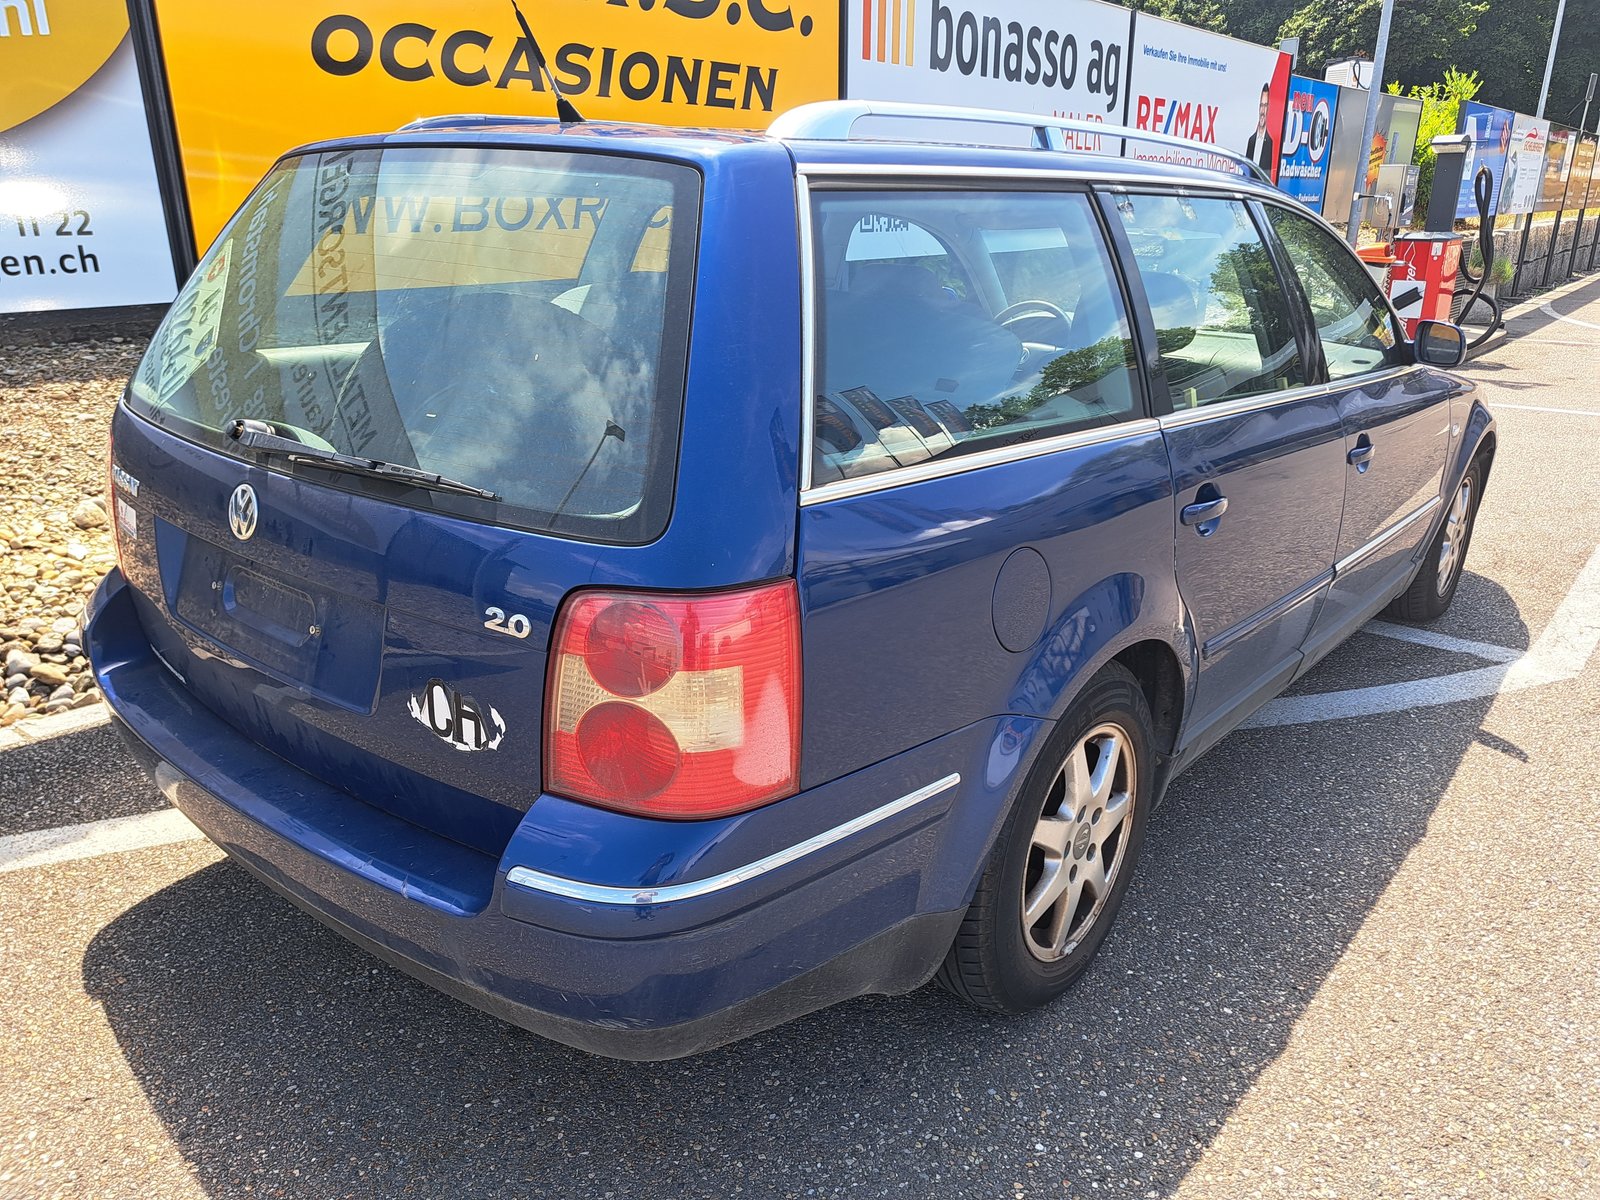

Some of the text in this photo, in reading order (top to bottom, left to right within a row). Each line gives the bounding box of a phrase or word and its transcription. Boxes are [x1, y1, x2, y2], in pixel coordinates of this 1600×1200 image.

[310, 14, 779, 112] OCCASIONEN
[930, 0, 1121, 113] bonasso ag
[1143, 44, 1168, 60] Verkaufen
[1168, 50, 1177, 62] Sie
[1178, 52, 1187, 64] Ihre
[1187, 55, 1210, 69] Immobilie
[1293, 91, 1314, 112] neu
[1136, 95, 1219, 144] RE/MAX
[1280, 159, 1322, 178] Radwäscher
[56, 210, 94, 237] 22
[0, 245, 100, 277] en.ch
